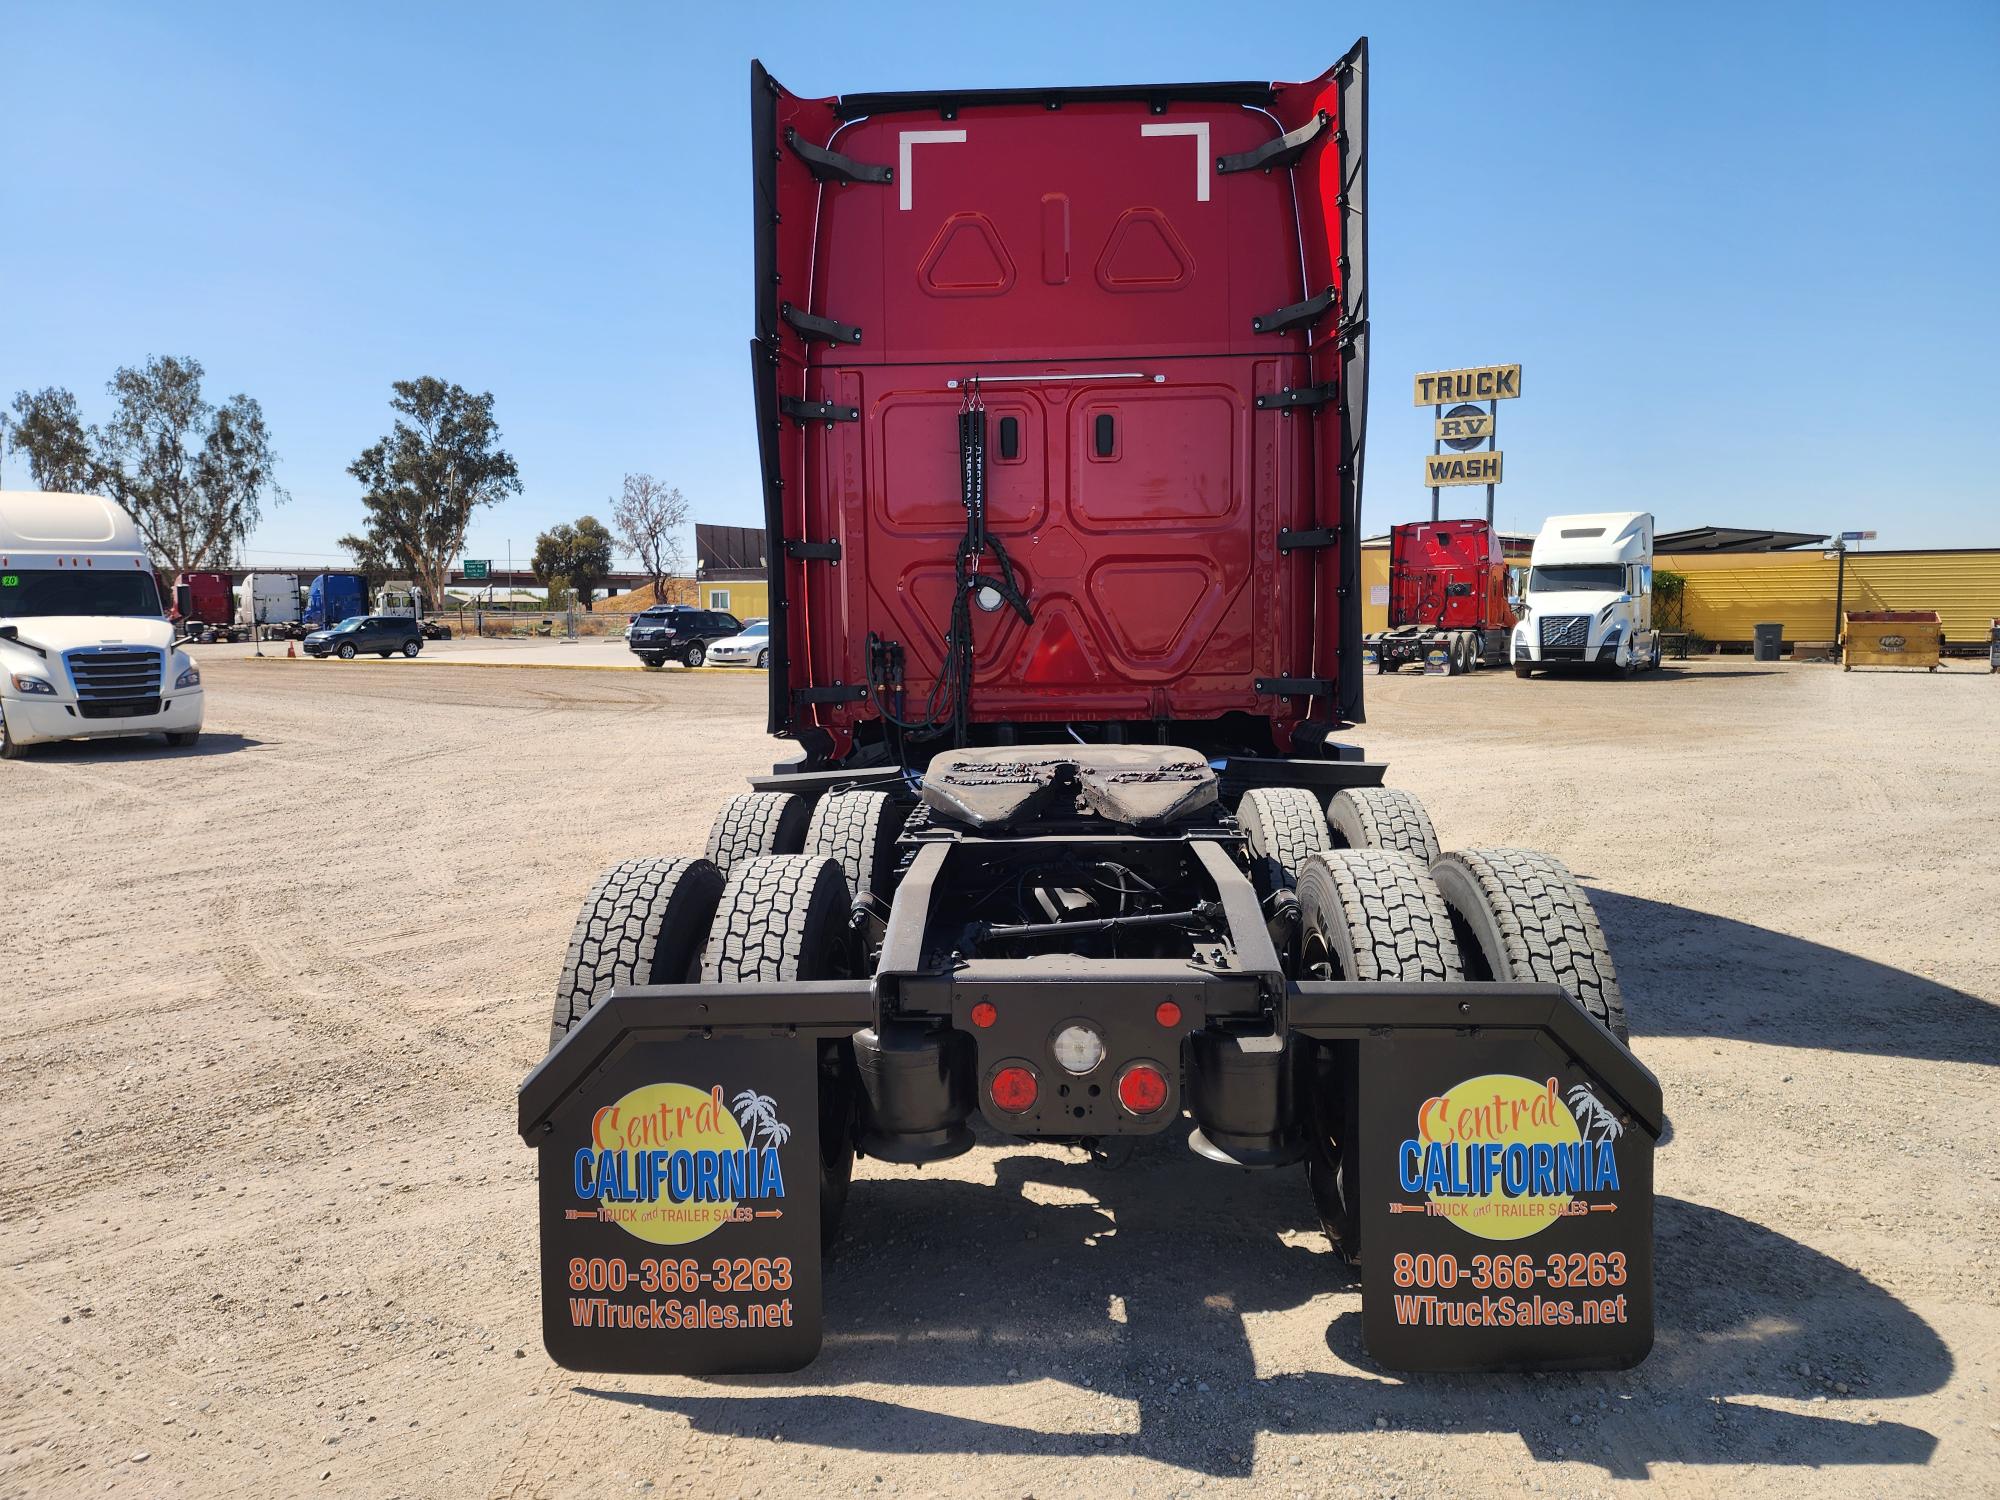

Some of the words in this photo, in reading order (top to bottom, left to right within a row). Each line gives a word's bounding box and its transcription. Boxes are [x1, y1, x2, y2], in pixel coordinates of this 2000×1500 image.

[1418, 369, 1515, 400] TRUCK
[1441, 418, 1488, 436] RV
[1429, 458, 1497, 480] WASH
[591, 1084, 726, 1153] Central
[1418, 1077, 1561, 1147] Central
[574, 1147, 785, 1202] CALIFORNIA
[1399, 1140, 1620, 1198] CALIFORNIA
[597, 1208, 637, 1222] TRUCK
[641, 1207, 658, 1222] and
[659, 1209, 710, 1222] TRAILER
[713, 1207, 753, 1222] SALES
[1424, 1202, 1469, 1217] TRUCK
[1473, 1202, 1491, 1218] and
[1494, 1203, 1545, 1217] TRAILER
[1548, 1201, 1588, 1217] SALES
[569, 1257, 792, 1292] 800-366-3263
[1393, 1251, 1627, 1289] 800-366-3263
[569, 1298, 793, 1329] WTruckSales.net
[1393, 1294, 1628, 1327] WTruckSales.net
